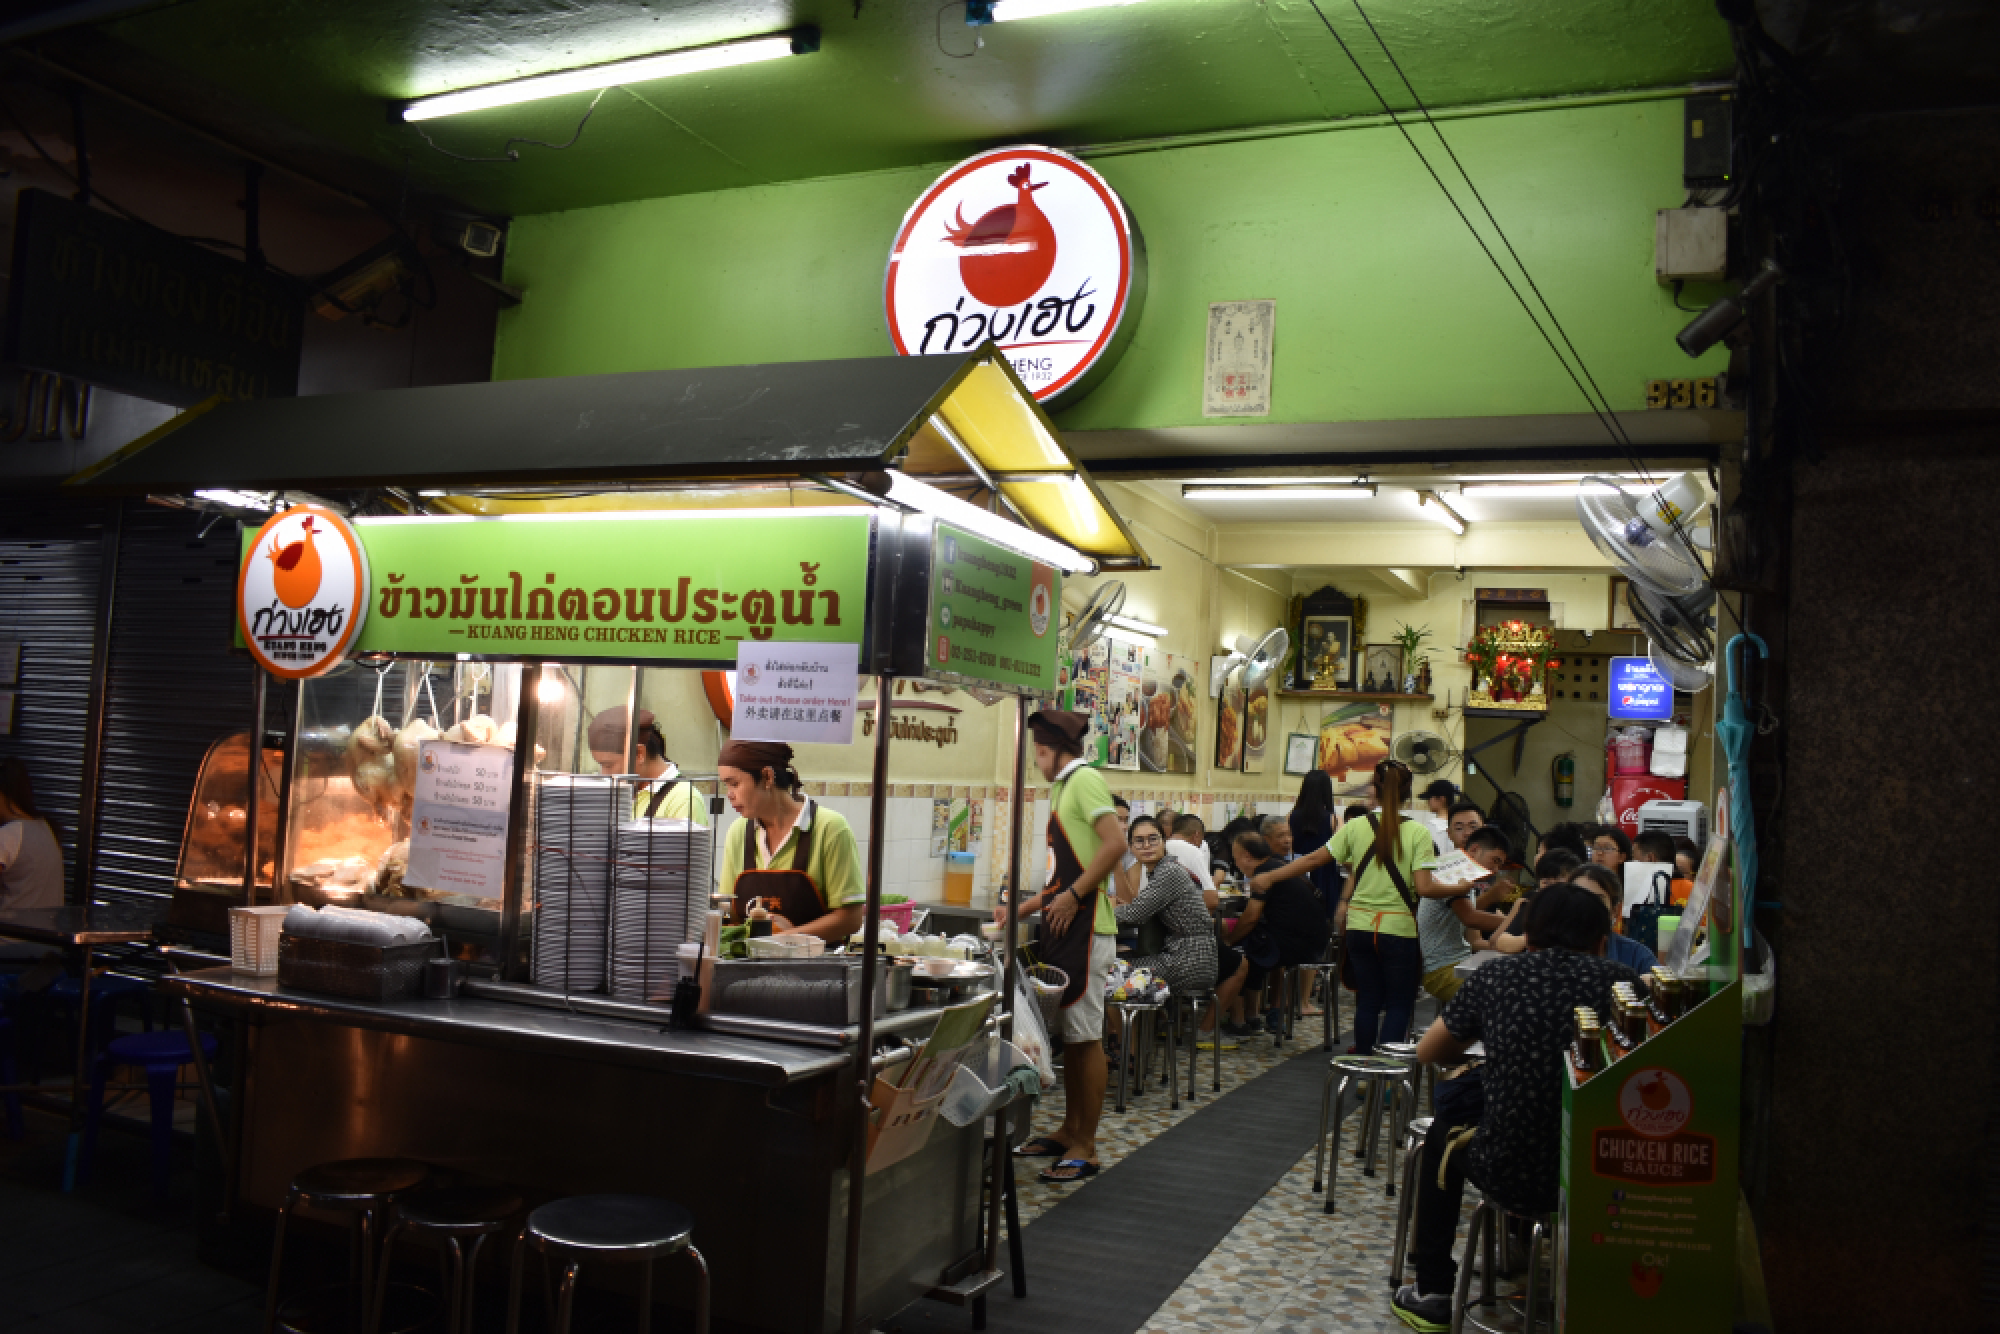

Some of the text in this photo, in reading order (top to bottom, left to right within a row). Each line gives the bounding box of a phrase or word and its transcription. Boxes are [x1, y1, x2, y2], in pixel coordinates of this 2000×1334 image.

[1647, 377, 1719, 409] 936
[379, 562, 841, 640] ข้าวมันไก่ตอนประตูน้ำ
[467, 625, 721, 645] KUANG HENG CHICKEN RICE
[739, 693, 851, 707] Take out Please order Here!
[745, 706, 843, 723] 外卖请在这里点餐
[1599, 1138, 1709, 1166] CHICKEN RICE
[1622, 1161, 1685, 1177] SAUCE
